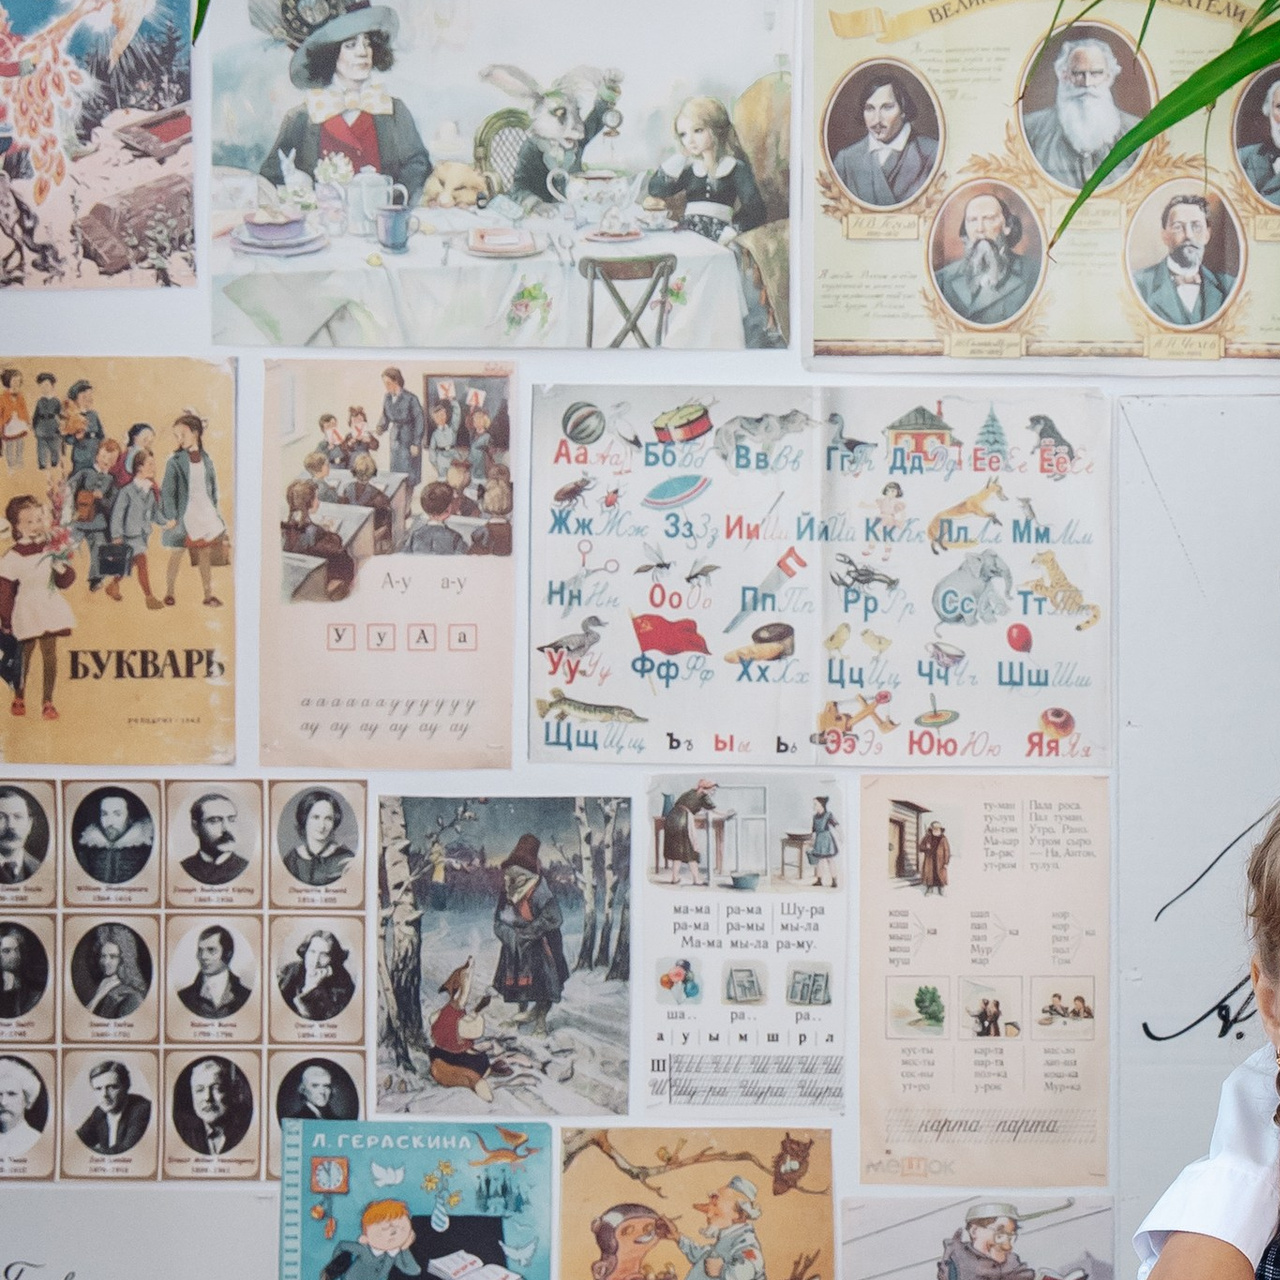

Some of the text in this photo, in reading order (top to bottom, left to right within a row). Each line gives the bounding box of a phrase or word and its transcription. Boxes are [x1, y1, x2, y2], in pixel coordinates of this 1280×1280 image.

[68, 648, 226, 680] БУКВАРЬ
[312, 1133, 472, 1150] Л. ГЕРАСКИНА
[918, 1117, 1058, 1143] карта парта
